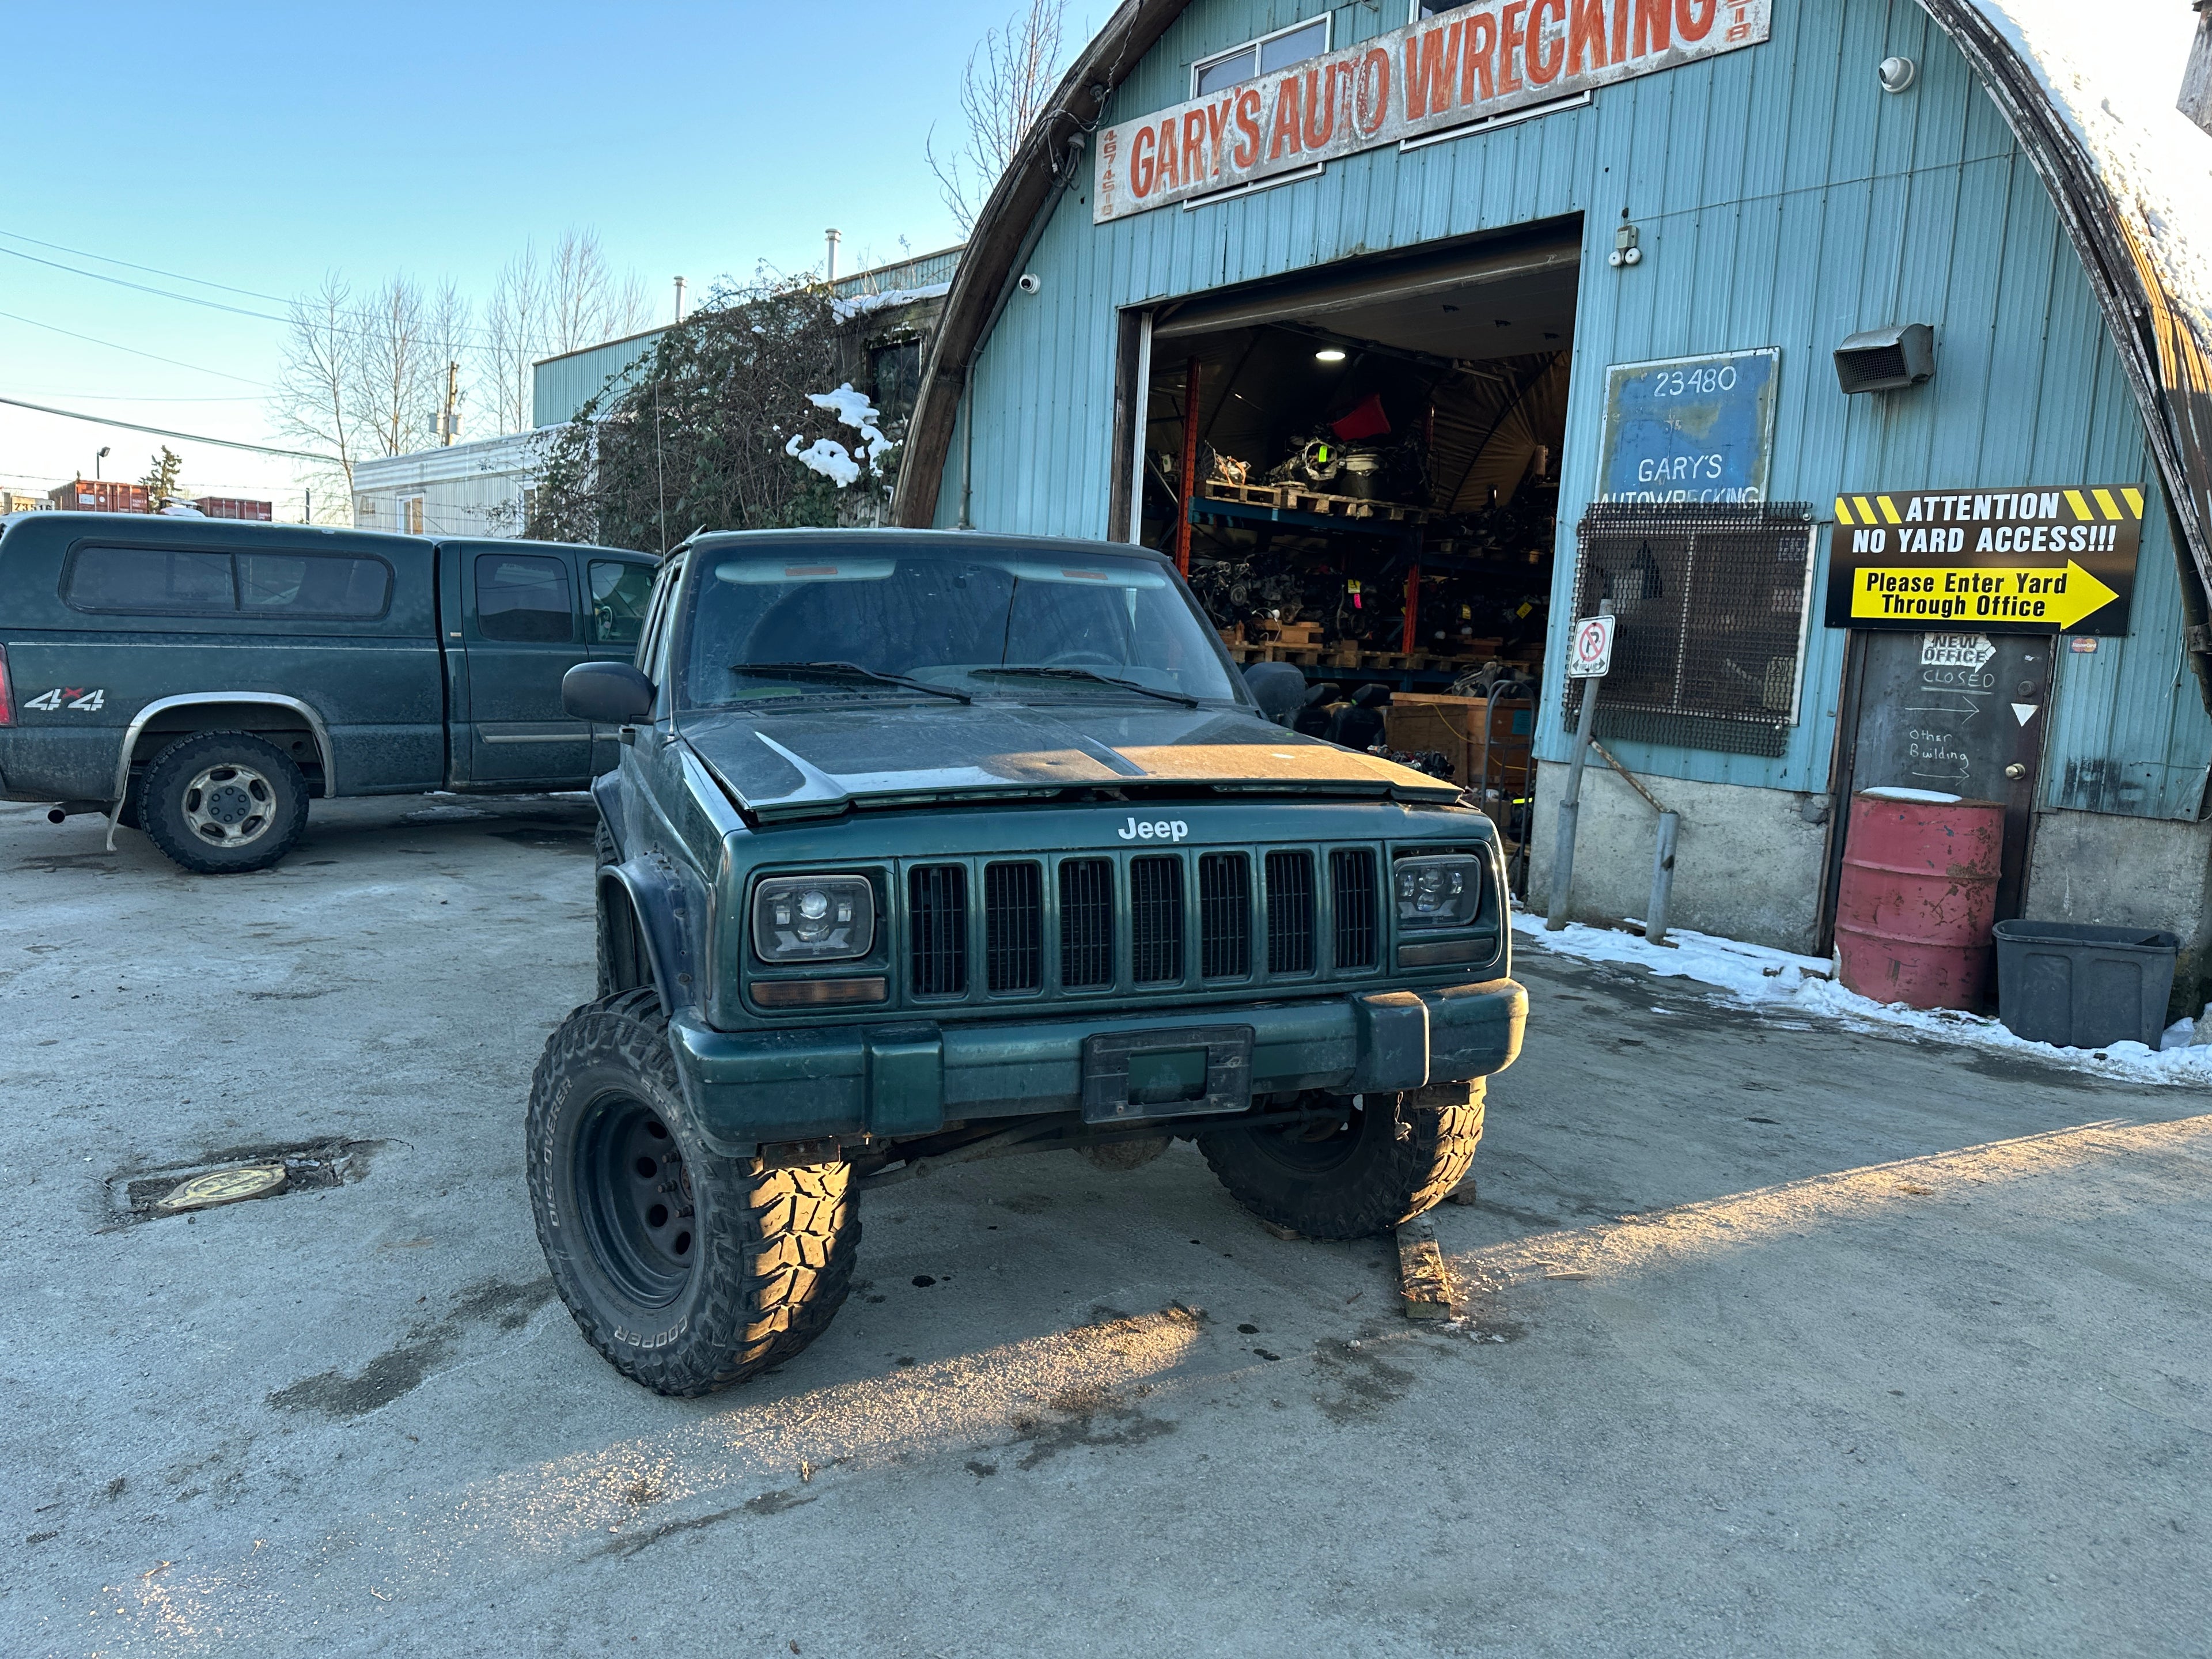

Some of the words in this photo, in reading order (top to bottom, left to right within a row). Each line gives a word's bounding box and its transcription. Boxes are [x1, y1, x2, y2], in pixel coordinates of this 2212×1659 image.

[1130, 86, 1261, 198] GARY'S
[1269, 47, 1391, 160] AUTO
[1653, 365, 1737, 397] 23480
[1638, 454, 1723, 483] GARY'S
[1905, 492, 2059, 522] ATTENTION
[1852, 528, 1886, 553] NO
[1899, 528, 1964, 553] YARD
[1975, 525, 2116, 552] ACCESS!!!
[1866, 572, 1934, 593] Please
[1944, 573, 2005, 593] Enter
[2017, 573, 2068, 594] Yard
[1881, 594, 1966, 618] Through
[1976, 595, 2046, 617] Office
[1924, 647, 1987, 663] OFFICE
[1934, 635, 1978, 648] NEW
[1923, 669, 1995, 688] CLOSED
[1910, 743, 1969, 770] Building
[1118, 817, 1188, 842] Jeep
[544, 1075, 574, 1228] DISCOVERER
[614, 1313, 688, 1349] COOPER
